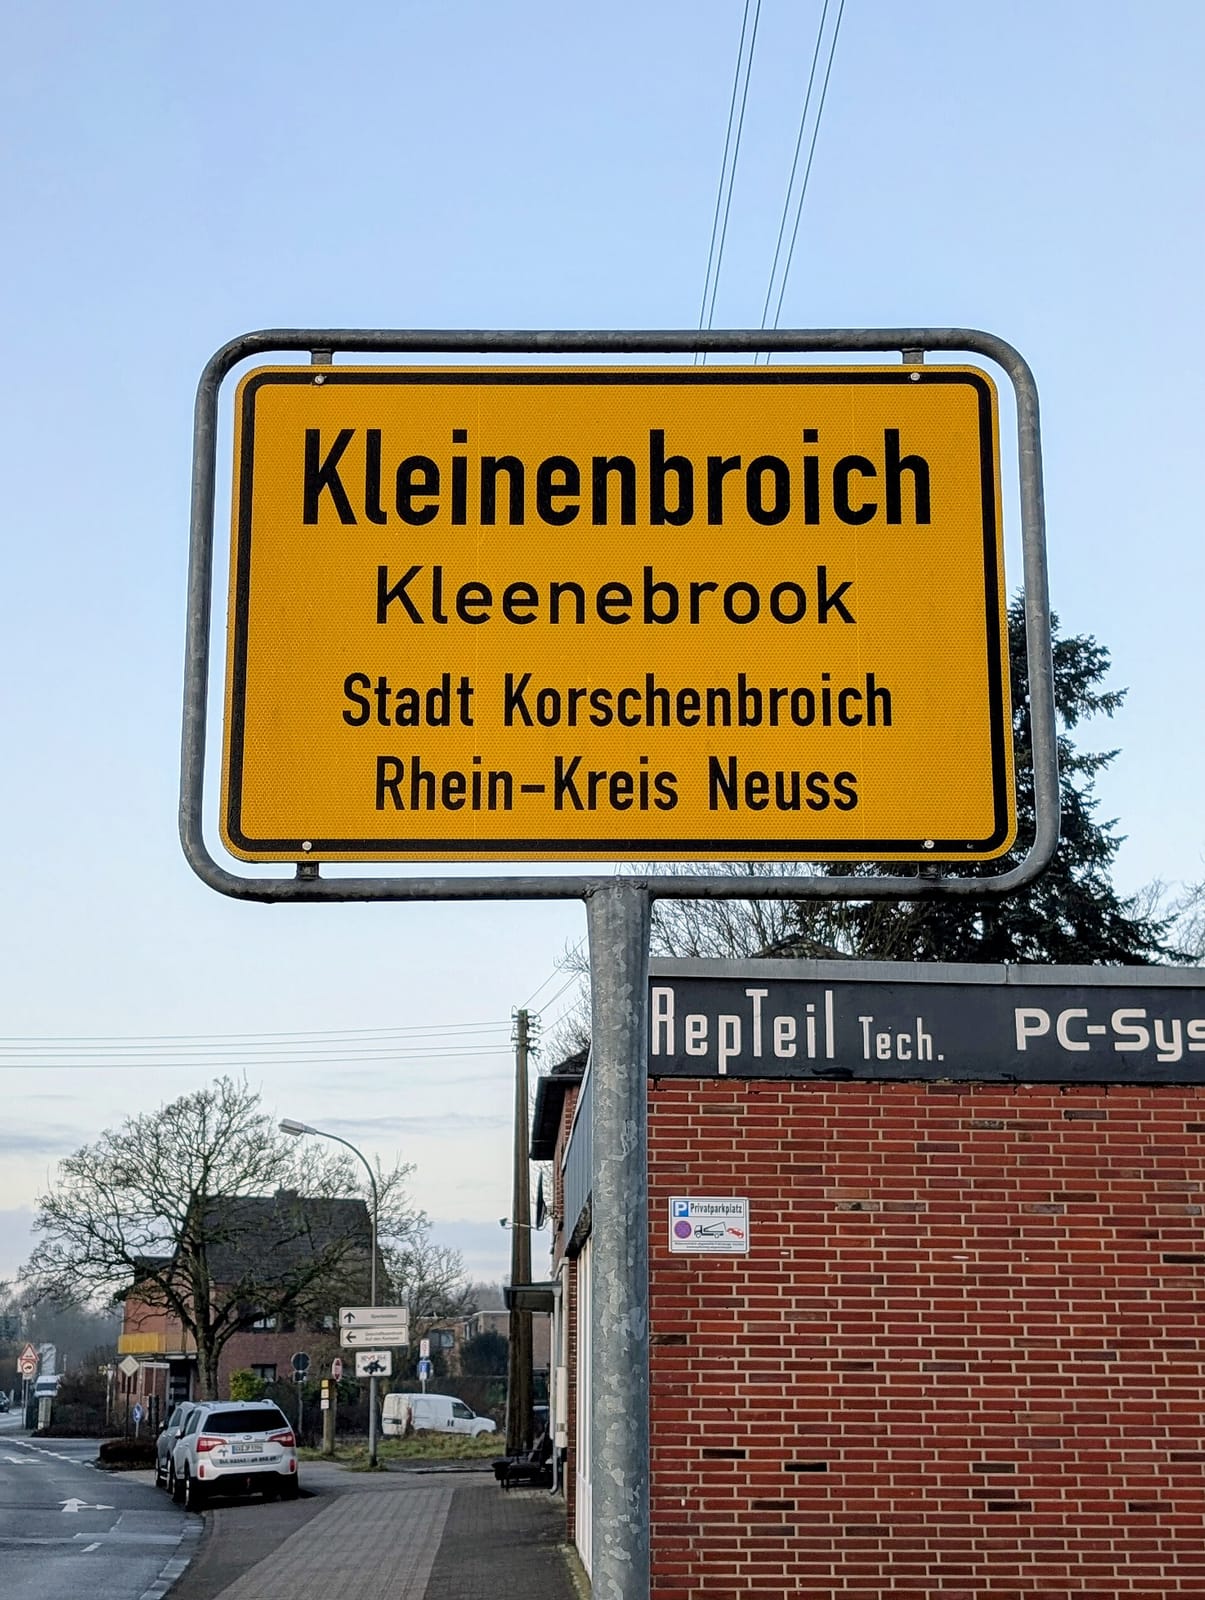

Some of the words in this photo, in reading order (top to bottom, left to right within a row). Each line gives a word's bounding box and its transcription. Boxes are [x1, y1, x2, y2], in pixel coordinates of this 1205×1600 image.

[303, 428, 931, 527] Kleinenbroich
[376, 565, 857, 625] Kleenebrook
[342, 672, 475, 727] Stadt
[504, 672, 892, 727] Korschenbroich
[375, 755, 680, 811] Rhein-Kreis
[708, 755, 859, 812] Neuss
[859, 1015, 945, 1062] Tech.
[690, 1202, 743, 1216] Privatparkplatz
